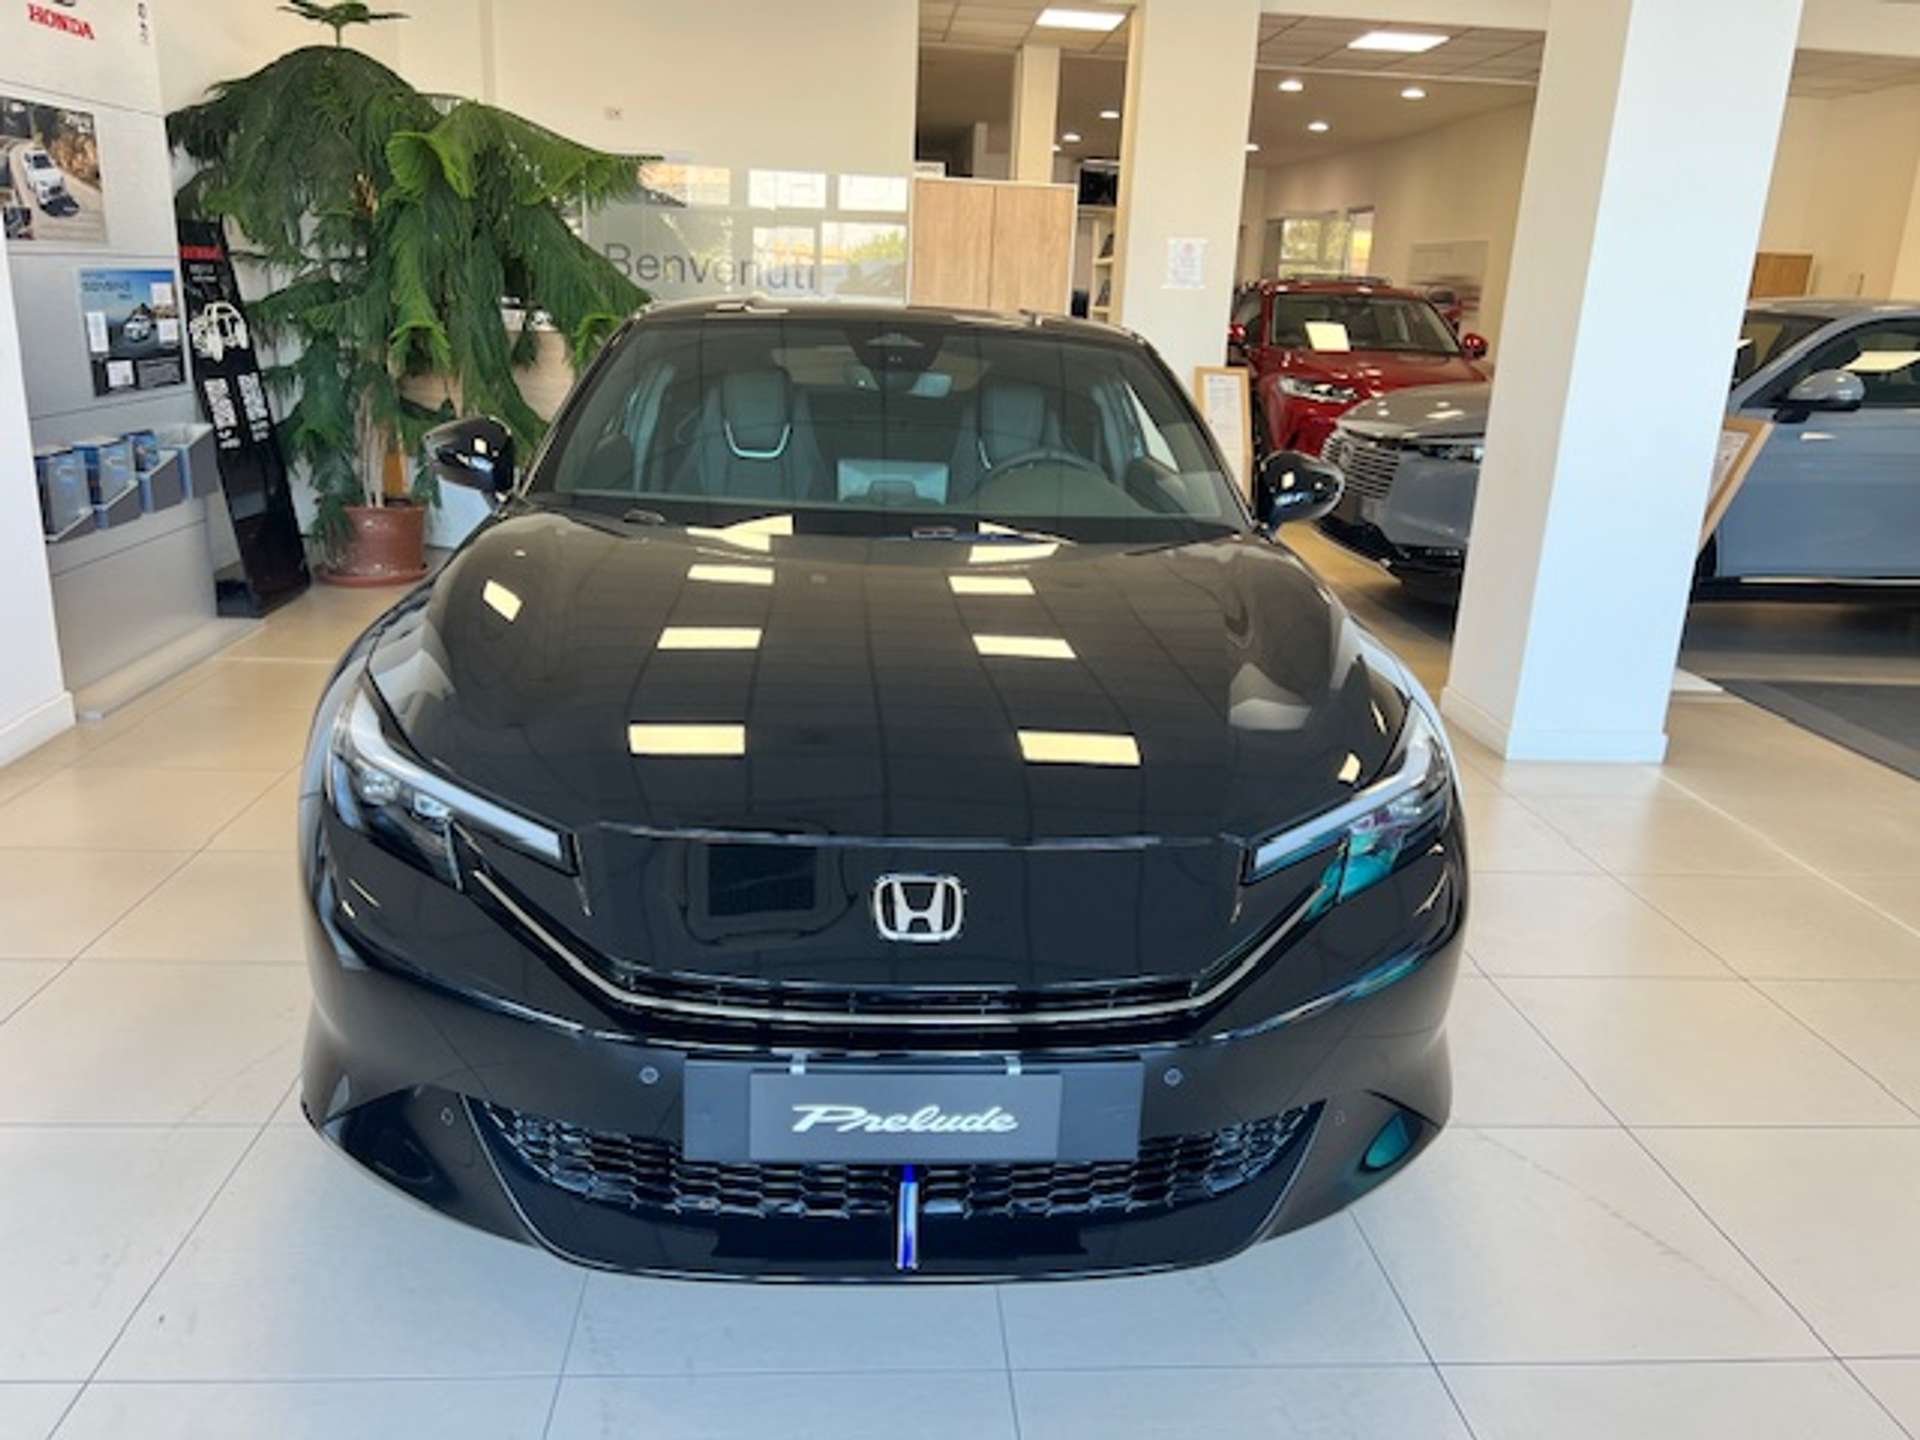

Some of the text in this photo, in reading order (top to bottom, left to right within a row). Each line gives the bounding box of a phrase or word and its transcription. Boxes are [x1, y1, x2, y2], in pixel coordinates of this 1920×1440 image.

[27, 3, 95, 40] HONDA
[605, 243, 816, 289] Benvenuti
[793, 1105, 1018, 1133] Prelude
